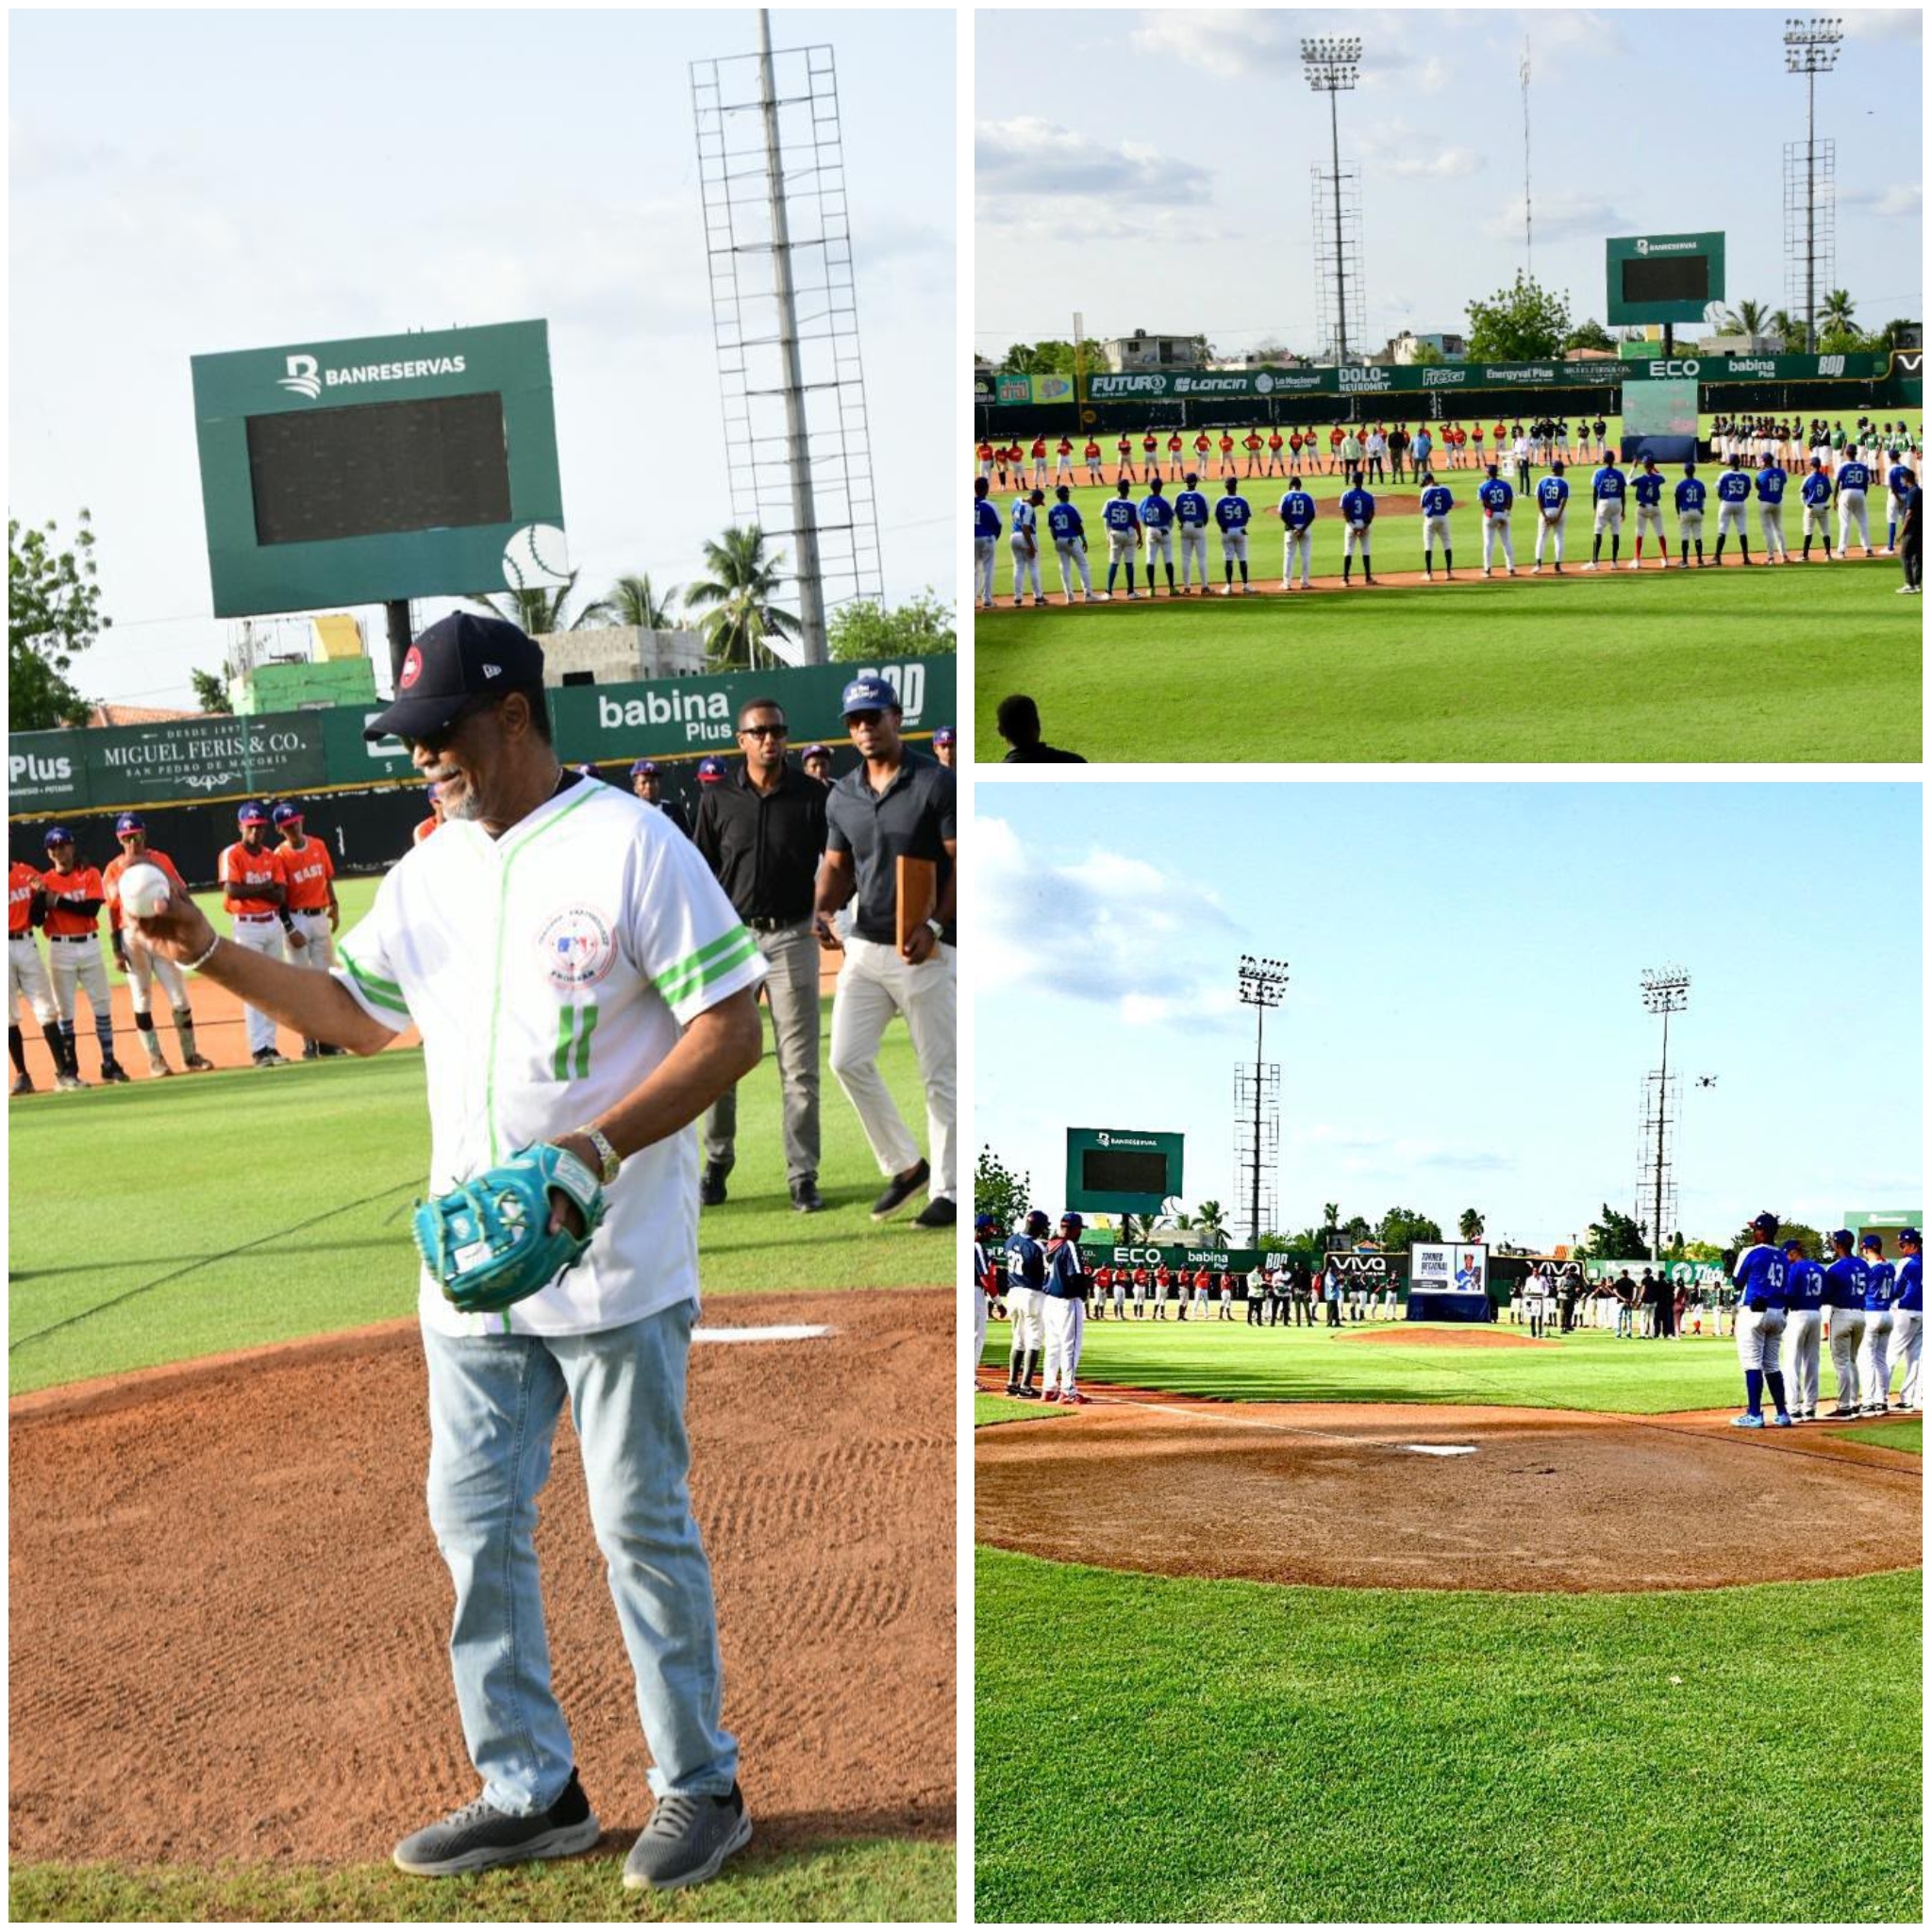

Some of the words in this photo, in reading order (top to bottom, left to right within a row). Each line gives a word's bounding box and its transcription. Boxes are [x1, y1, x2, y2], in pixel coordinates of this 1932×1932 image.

[325, 356, 466, 386] BANRESERVAS
[1650, 359, 1700, 376] ECO
[1728, 358, 1775, 372] babina
[1533, 369, 1554, 378] Plus
[1769, 477, 1780, 491] 16
[1848, 471, 1863, 483] 50
[1604, 478, 1617, 492] 32
[1728, 480, 1744, 494] 53
[1490, 489, 1505, 504] 33
[1545, 486, 1558, 500] 39
[1686, 489, 1697, 503] 31
[1183, 501, 1197, 515] 23
[1291, 500, 1305, 514] 13
[1355, 500, 1362, 514] 3
[1434, 496, 1441, 510] 5
[1111, 508, 1128, 524] 58
[1224, 505, 1242, 519] 54
[1054, 514, 1068, 530] 30
[599, 689, 729, 728] babina
[167, 728, 208, 739] DESDE
[686, 722, 732, 741] Plus
[105, 743, 185, 767] MIGUEL
[189, 737, 245, 758] FERIS
[249, 736, 264, 753] &
[269, 733, 307, 751] CO.
[9, 754, 72, 783] Plus
[125, 767, 151, 777] SAN
[158, 762, 200, 774] PEDRO
[207, 760, 225, 771] DE
[293, 863, 323, 884] EAST
[1113, 1247, 1160, 1263] ECO
[1188, 1251, 1228, 1262] babina
[1767, 1262, 1784, 1288] 43
[1806, 1274, 1823, 1297] 13
[1851, 1273, 1866, 1296] 15
